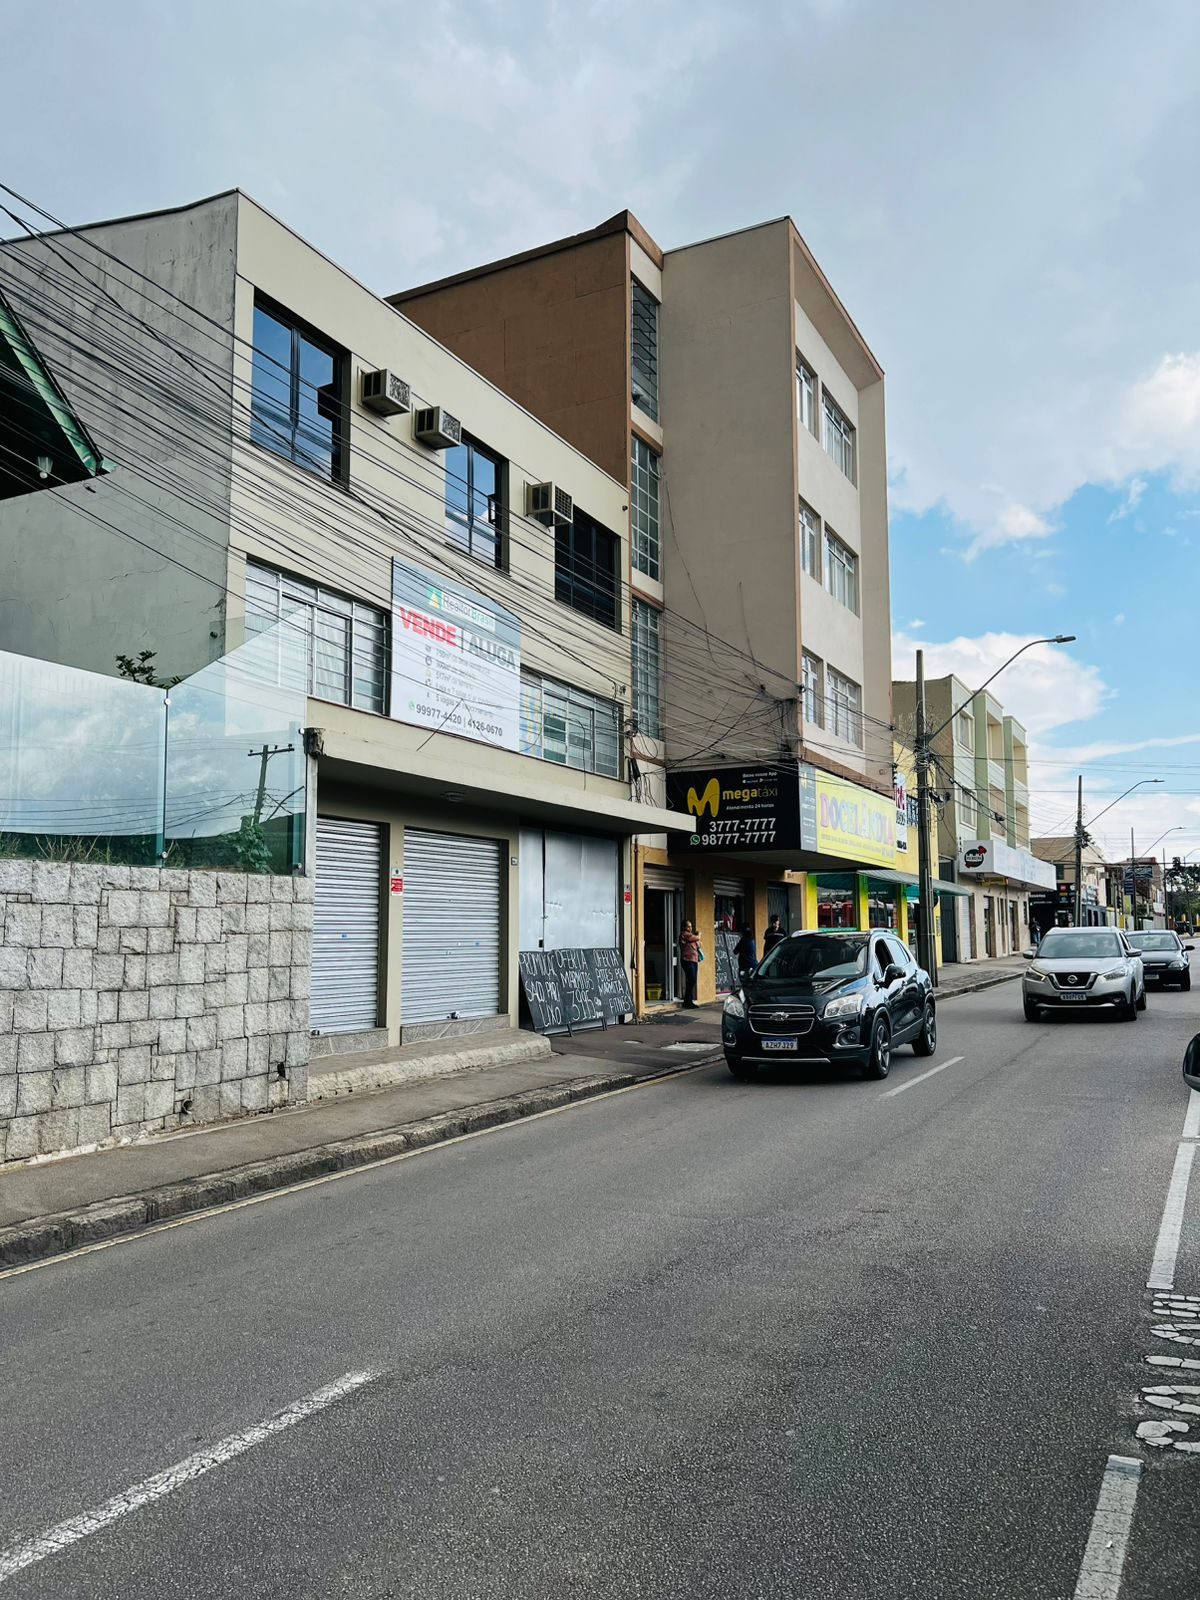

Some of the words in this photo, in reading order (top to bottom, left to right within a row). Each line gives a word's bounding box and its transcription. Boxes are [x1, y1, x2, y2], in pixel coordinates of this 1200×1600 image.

[399, 607, 457, 647] VENDE
[469, 634, 516, 670] ALUGA
[416, 703, 462, 724] 99977-4420
[468, 718, 503, 737] 4126-0670
[709, 817, 776, 832] 3777-7777
[701, 831, 776, 846] 98777-7777
[555, 949, 589, 970] OFERTA
[593, 949, 619, 968] OFERTA
